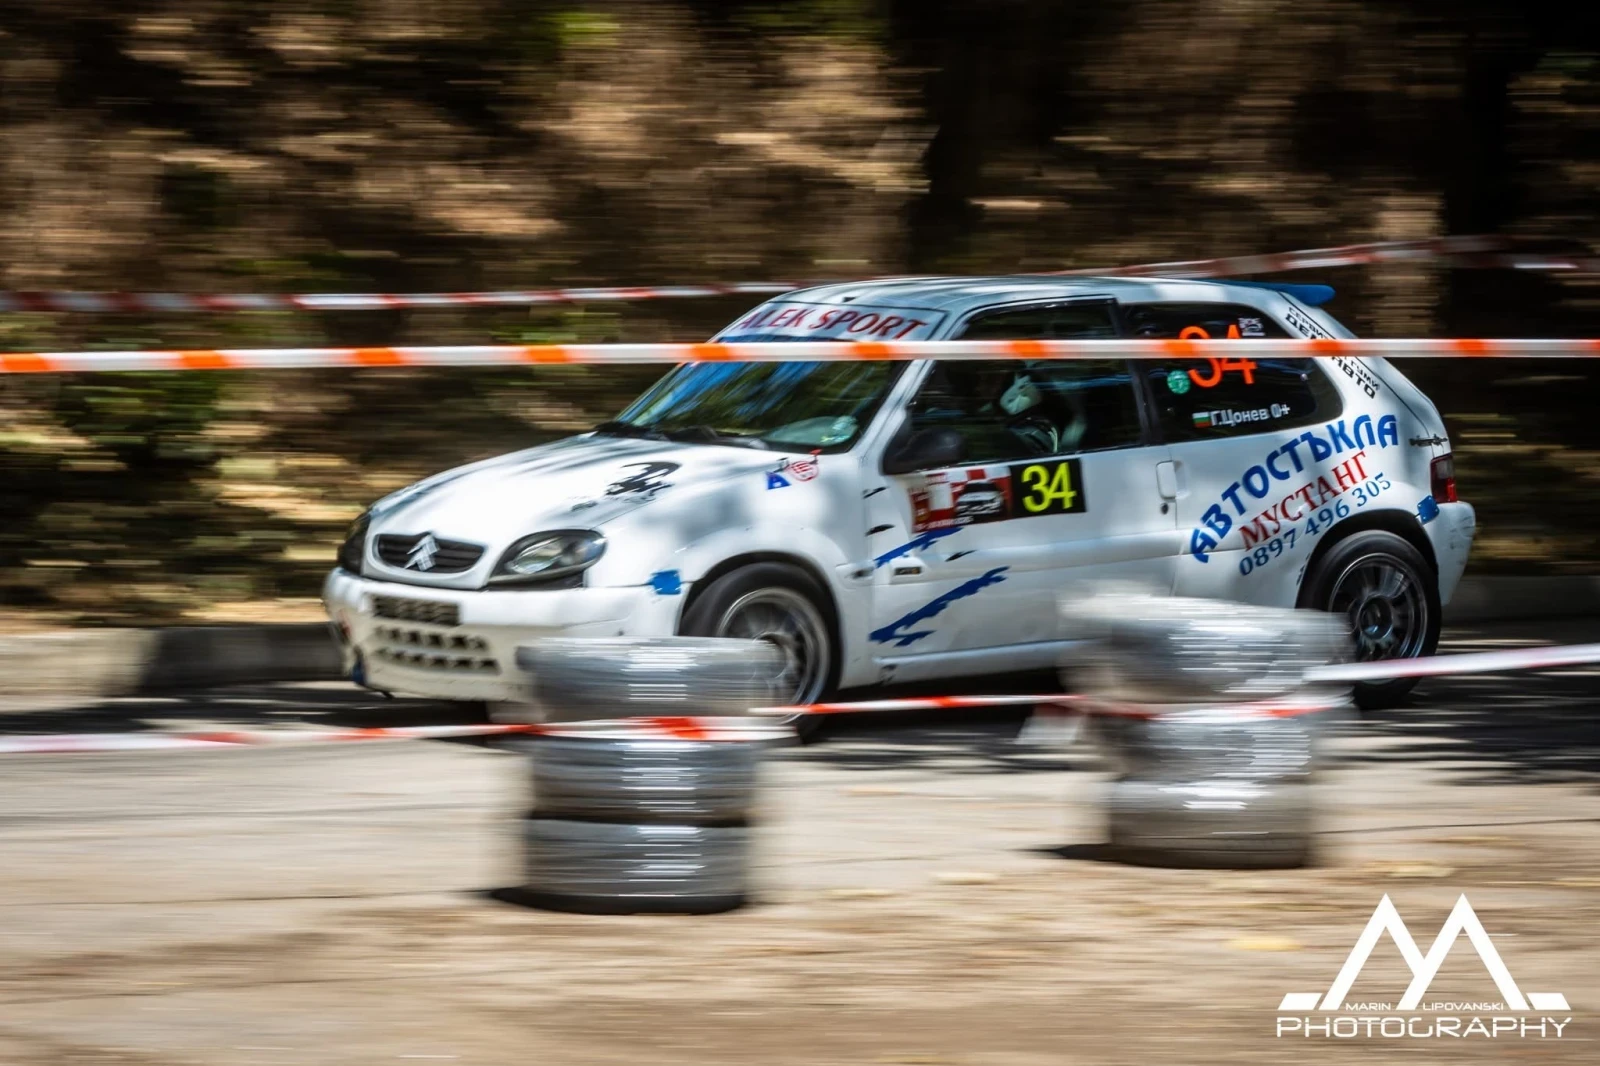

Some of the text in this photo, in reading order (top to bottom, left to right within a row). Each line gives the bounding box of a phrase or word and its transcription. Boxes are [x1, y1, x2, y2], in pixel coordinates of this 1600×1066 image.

[738, 308, 929, 340] ALEK SPORT
[1021, 462, 1077, 513] 34
[1190, 414, 1399, 563] АВТОСТЪКЛА
[1238, 451, 1369, 552] МУСТАНГ
[1239, 472, 1391, 576] 0897 496 305
